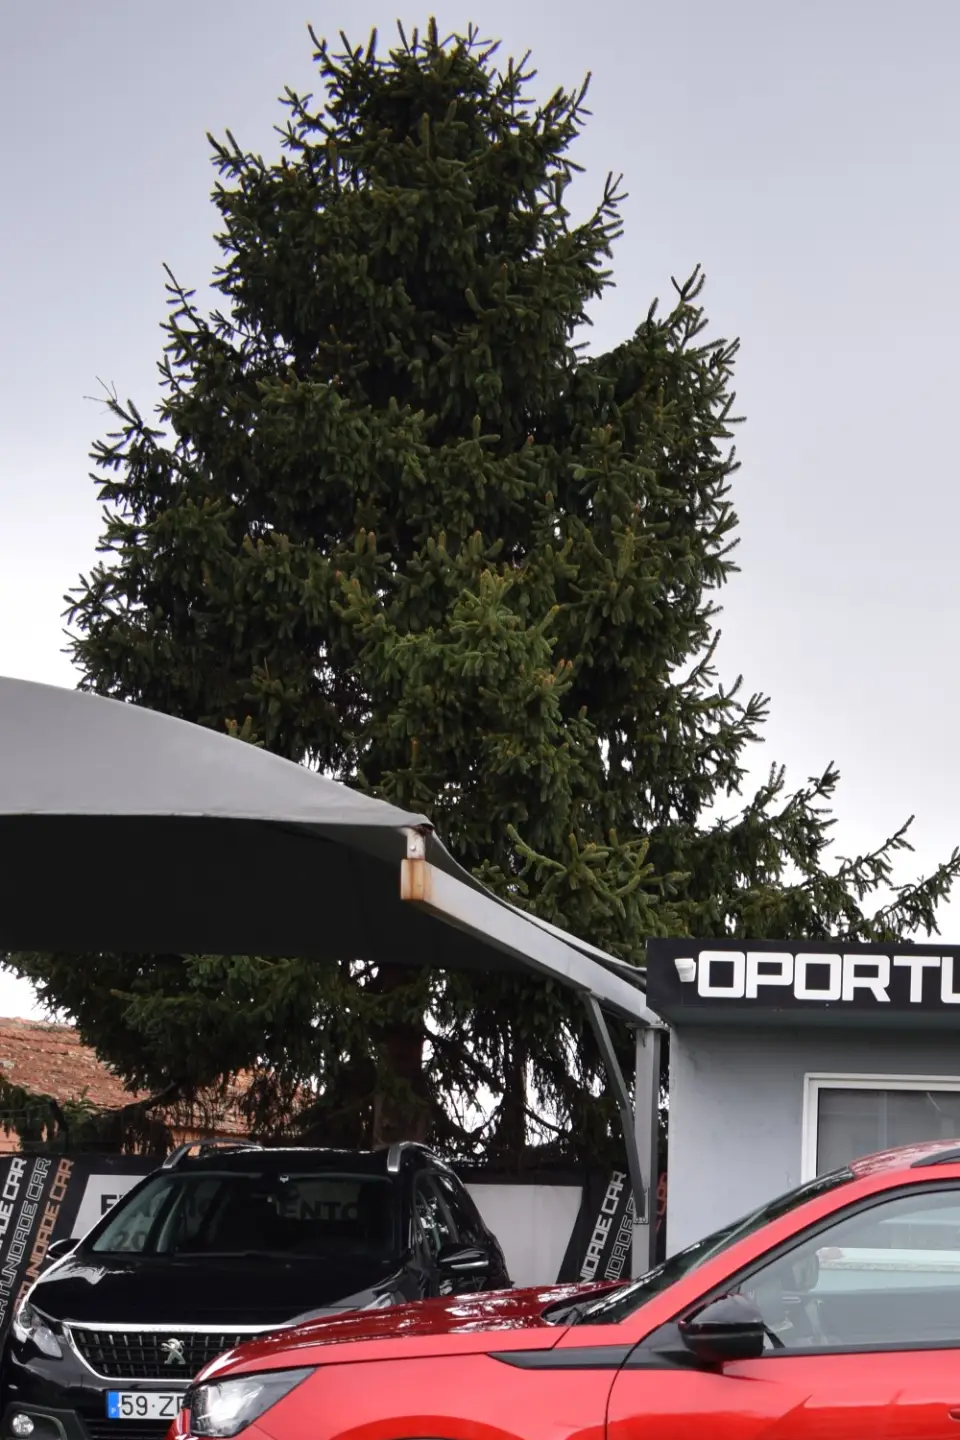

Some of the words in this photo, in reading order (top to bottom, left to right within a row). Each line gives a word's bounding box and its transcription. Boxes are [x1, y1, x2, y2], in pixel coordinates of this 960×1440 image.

[3, 1157, 27, 1200] CAR
[26, 1157, 51, 1201] CAR
[50, 1158, 74, 1201] CAR
[601, 1171, 627, 1214] CAR
